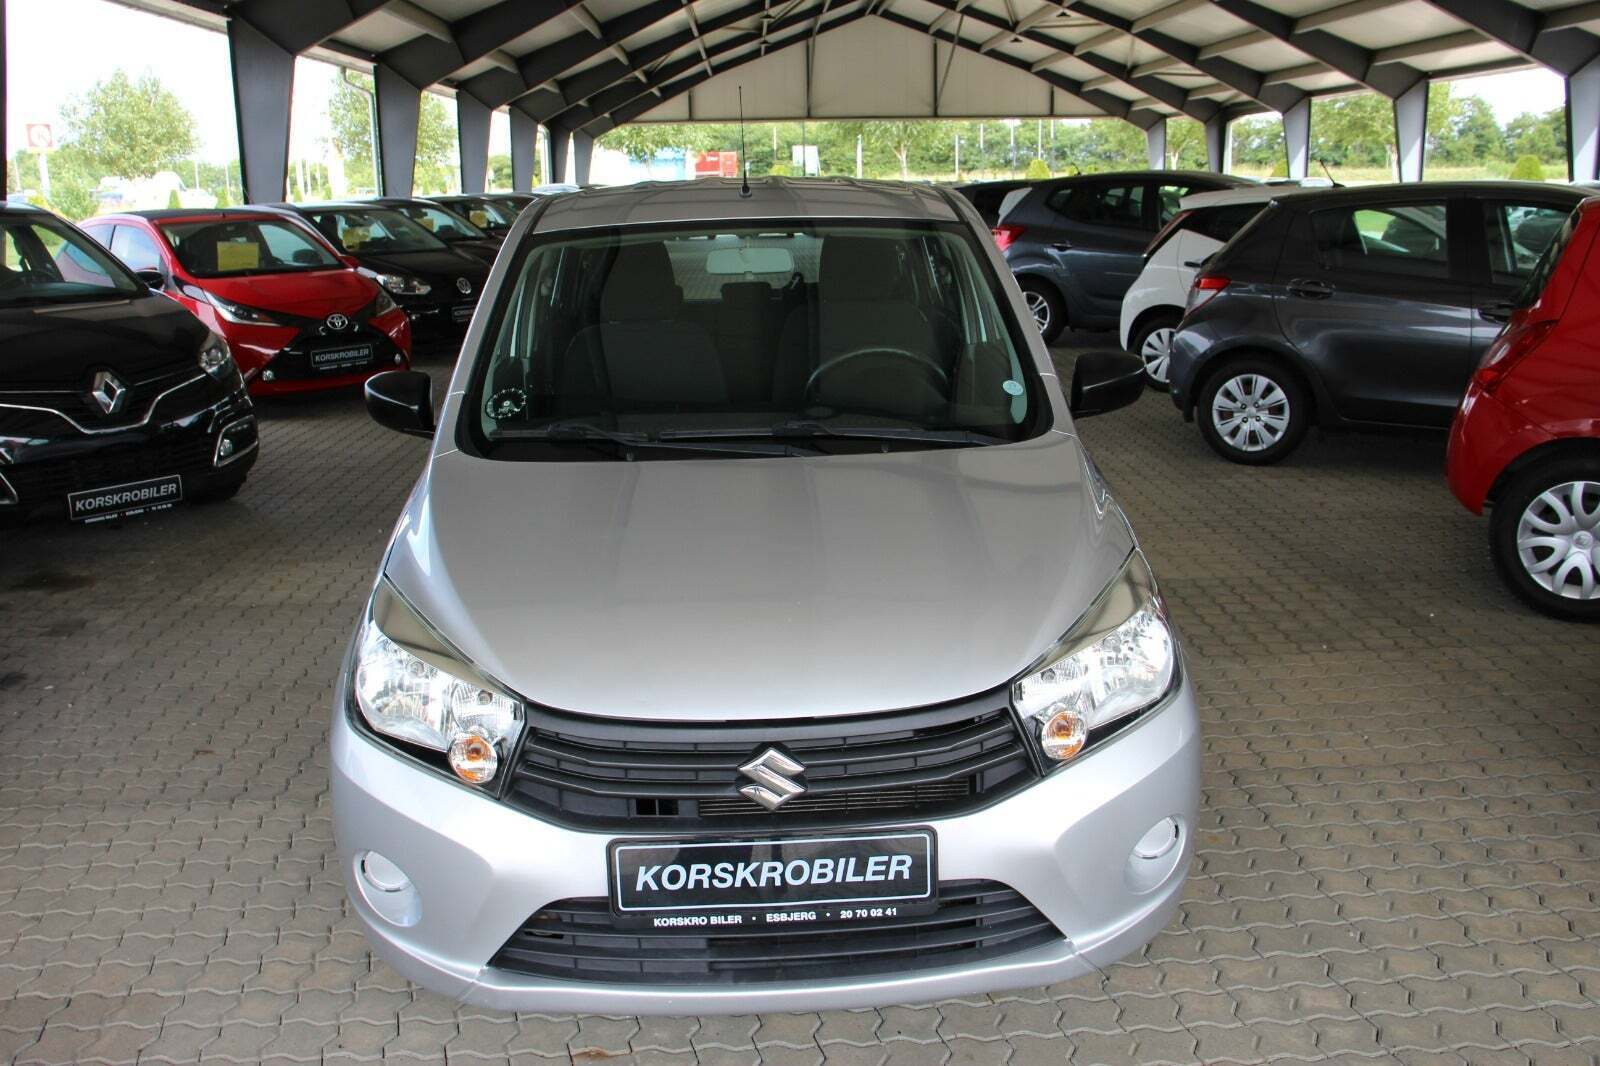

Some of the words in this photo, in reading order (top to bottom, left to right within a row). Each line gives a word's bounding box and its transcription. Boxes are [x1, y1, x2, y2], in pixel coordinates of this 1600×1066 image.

[75, 483, 177, 512] KORSKROBILER
[635, 854, 913, 892] KORSKROBILER
[653, 916, 708, 927] KORSKRO
[710, 915, 743, 925] BILER
[766, 911, 817, 923] ESBJERG
[840, 910, 853, 919] 20
[856, 909, 868, 918] 70
[870, 908, 883, 917] 02
[885, 907, 897, 916] 41
